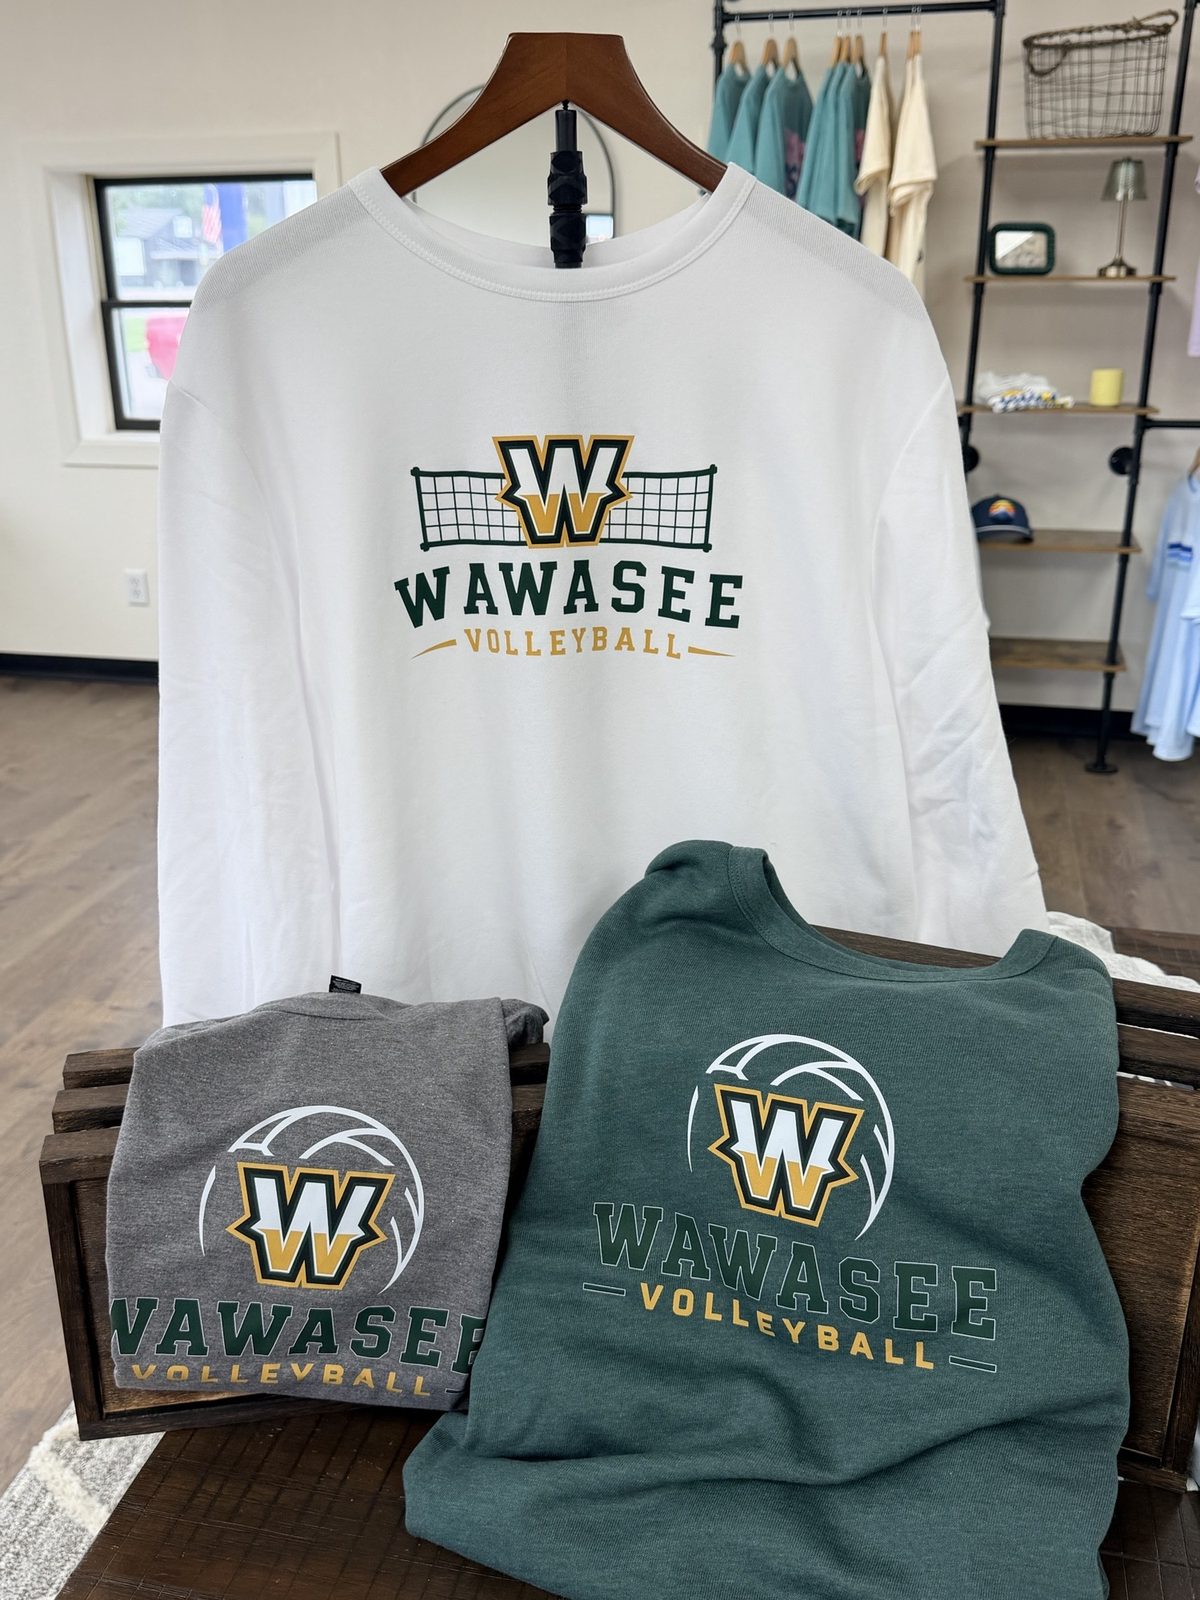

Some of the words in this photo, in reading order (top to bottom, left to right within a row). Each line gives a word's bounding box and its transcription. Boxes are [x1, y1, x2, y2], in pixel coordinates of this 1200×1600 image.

[492, 435, 635, 549] W
[394, 560, 743, 629] WAWASEE
[464, 626, 681, 660] VOLLEYBALL
[707, 1083, 865, 1228] W
[225, 1161, 396, 1290] W
[592, 1202, 998, 1341] WAWASEE
[640, 1282, 935, 1370] VOLLEYBALL
[132, 1362, 431, 1397] VOLLEYBALL
